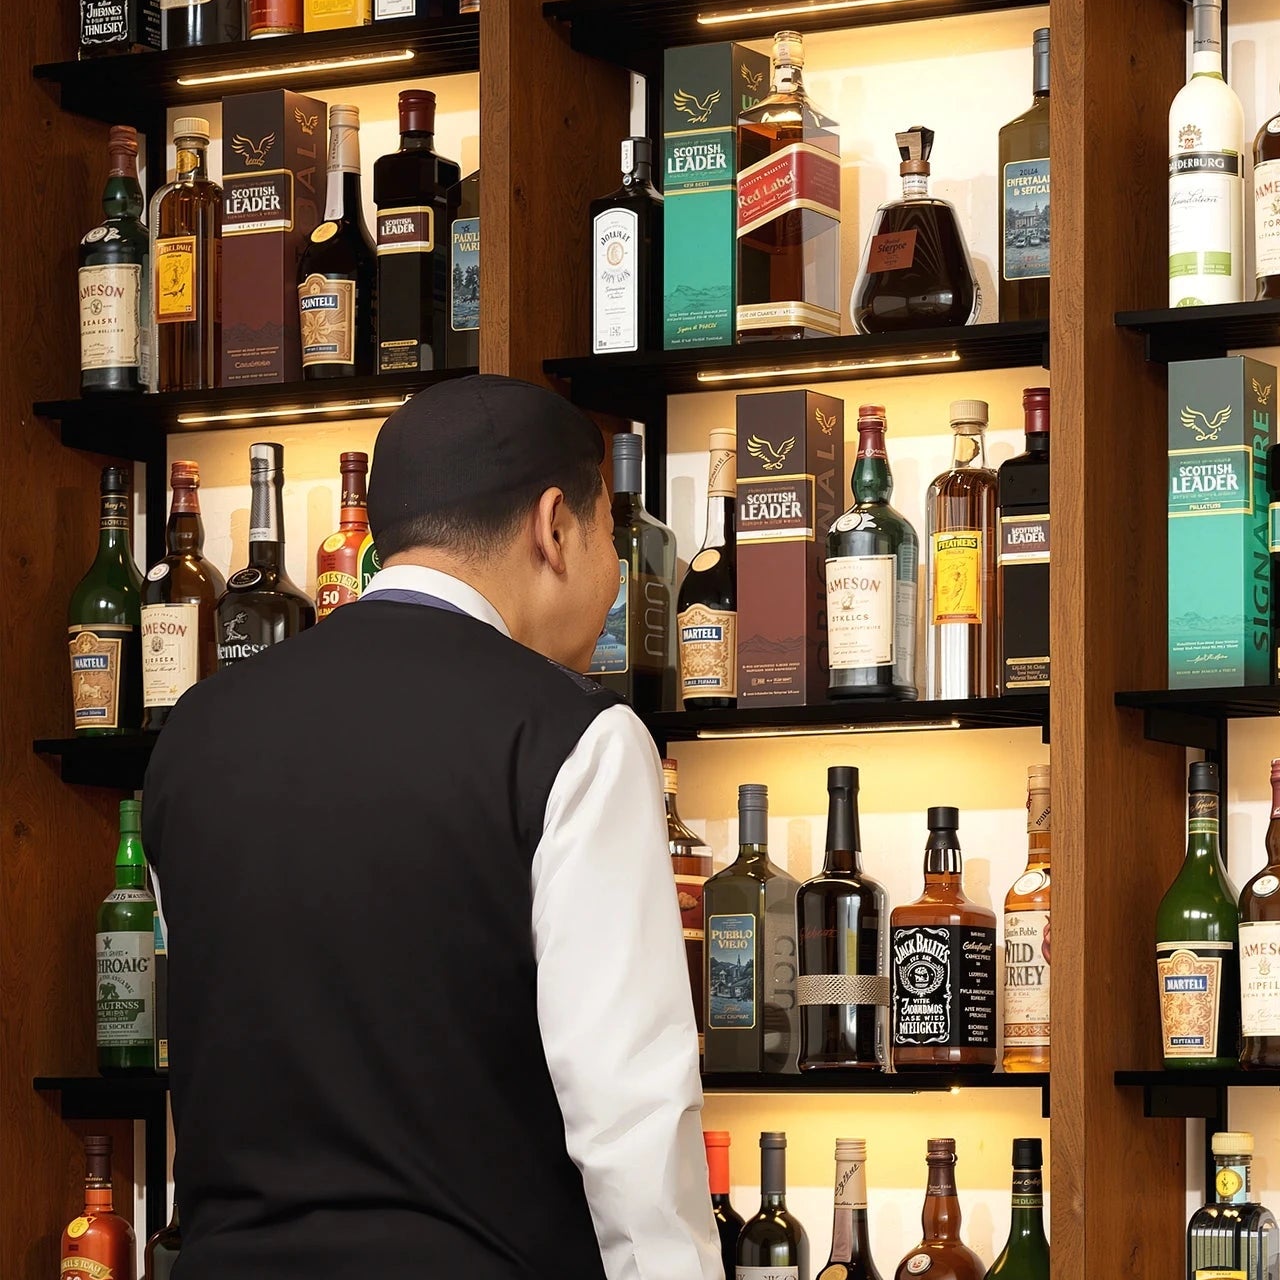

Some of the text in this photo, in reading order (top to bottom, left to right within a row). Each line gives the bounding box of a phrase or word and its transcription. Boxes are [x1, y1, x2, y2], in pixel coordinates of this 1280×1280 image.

[674, 144, 721, 158] SCOTTISH
[668, 154, 727, 174] LEADER
[231, 185, 275, 200] SCOTTISH
[739, 170, 797, 208] Red Label
[226, 195, 281, 215] LEADER
[381, 223, 415, 235] LEADER
[79, 284, 124, 300] AMESON
[1179, 464, 1232, 477] SCOTTISH
[1172, 473, 1239, 494] LEADER
[747, 492, 796, 504] SCOTTISH
[741, 502, 802, 520] LEADER
[1007, 532, 1045, 544] LEADER
[1004, 966, 1044, 987] URKEY
